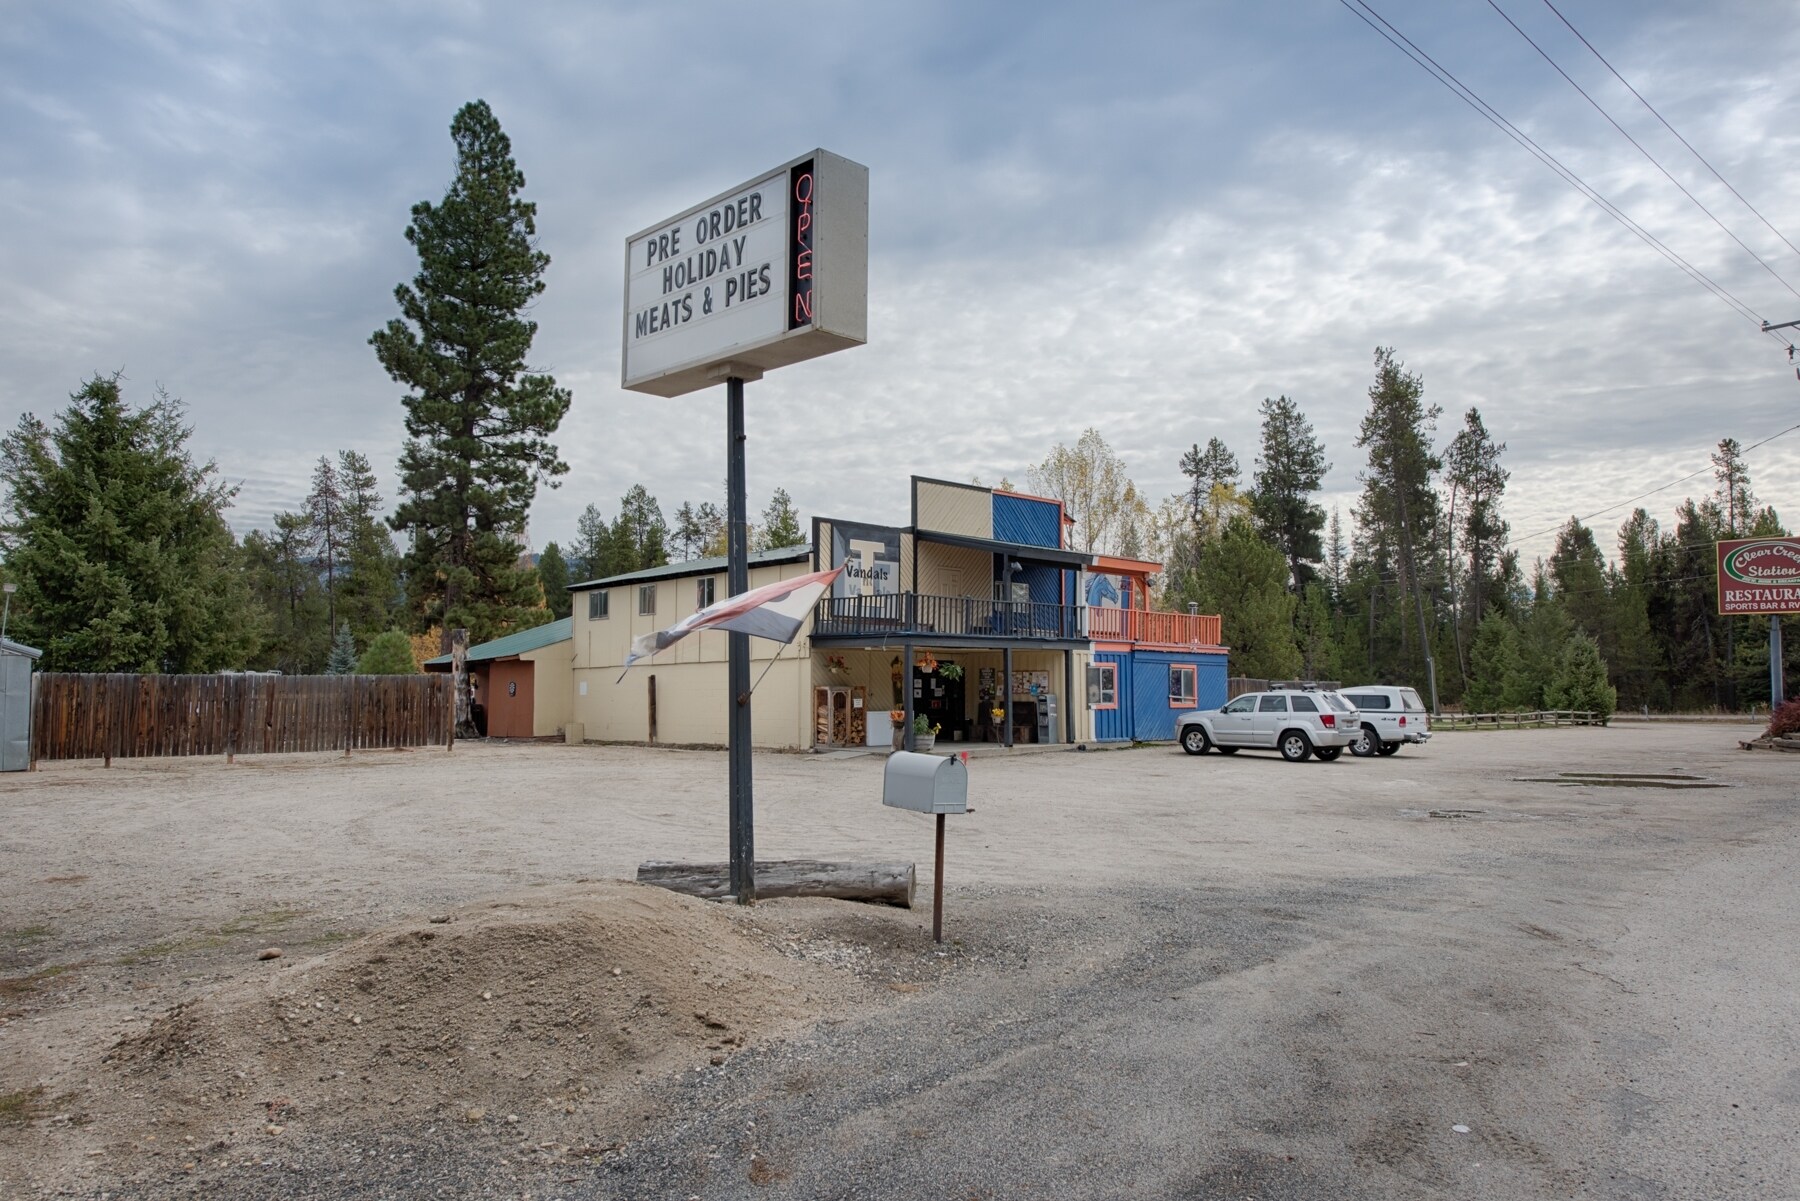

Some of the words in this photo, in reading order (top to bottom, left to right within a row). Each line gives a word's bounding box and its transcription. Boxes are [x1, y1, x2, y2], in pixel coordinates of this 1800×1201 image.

[647, 227, 681, 267] PRE
[696, 192, 762, 245] ORDER
[795, 173, 813, 322] OPEN
[662, 235, 747, 295] HOLIDAY
[635, 292, 693, 339] MEATS
[702, 286, 713, 315] &
[725, 262, 771, 308] PIES
[846, 565, 888, 580] Vandals
[1735, 549, 1771, 568] Clear
[1748, 565, 1800, 577] Station
[1725, 602, 1758, 611] SPORTS
[1760, 602, 1778, 610] BAR
